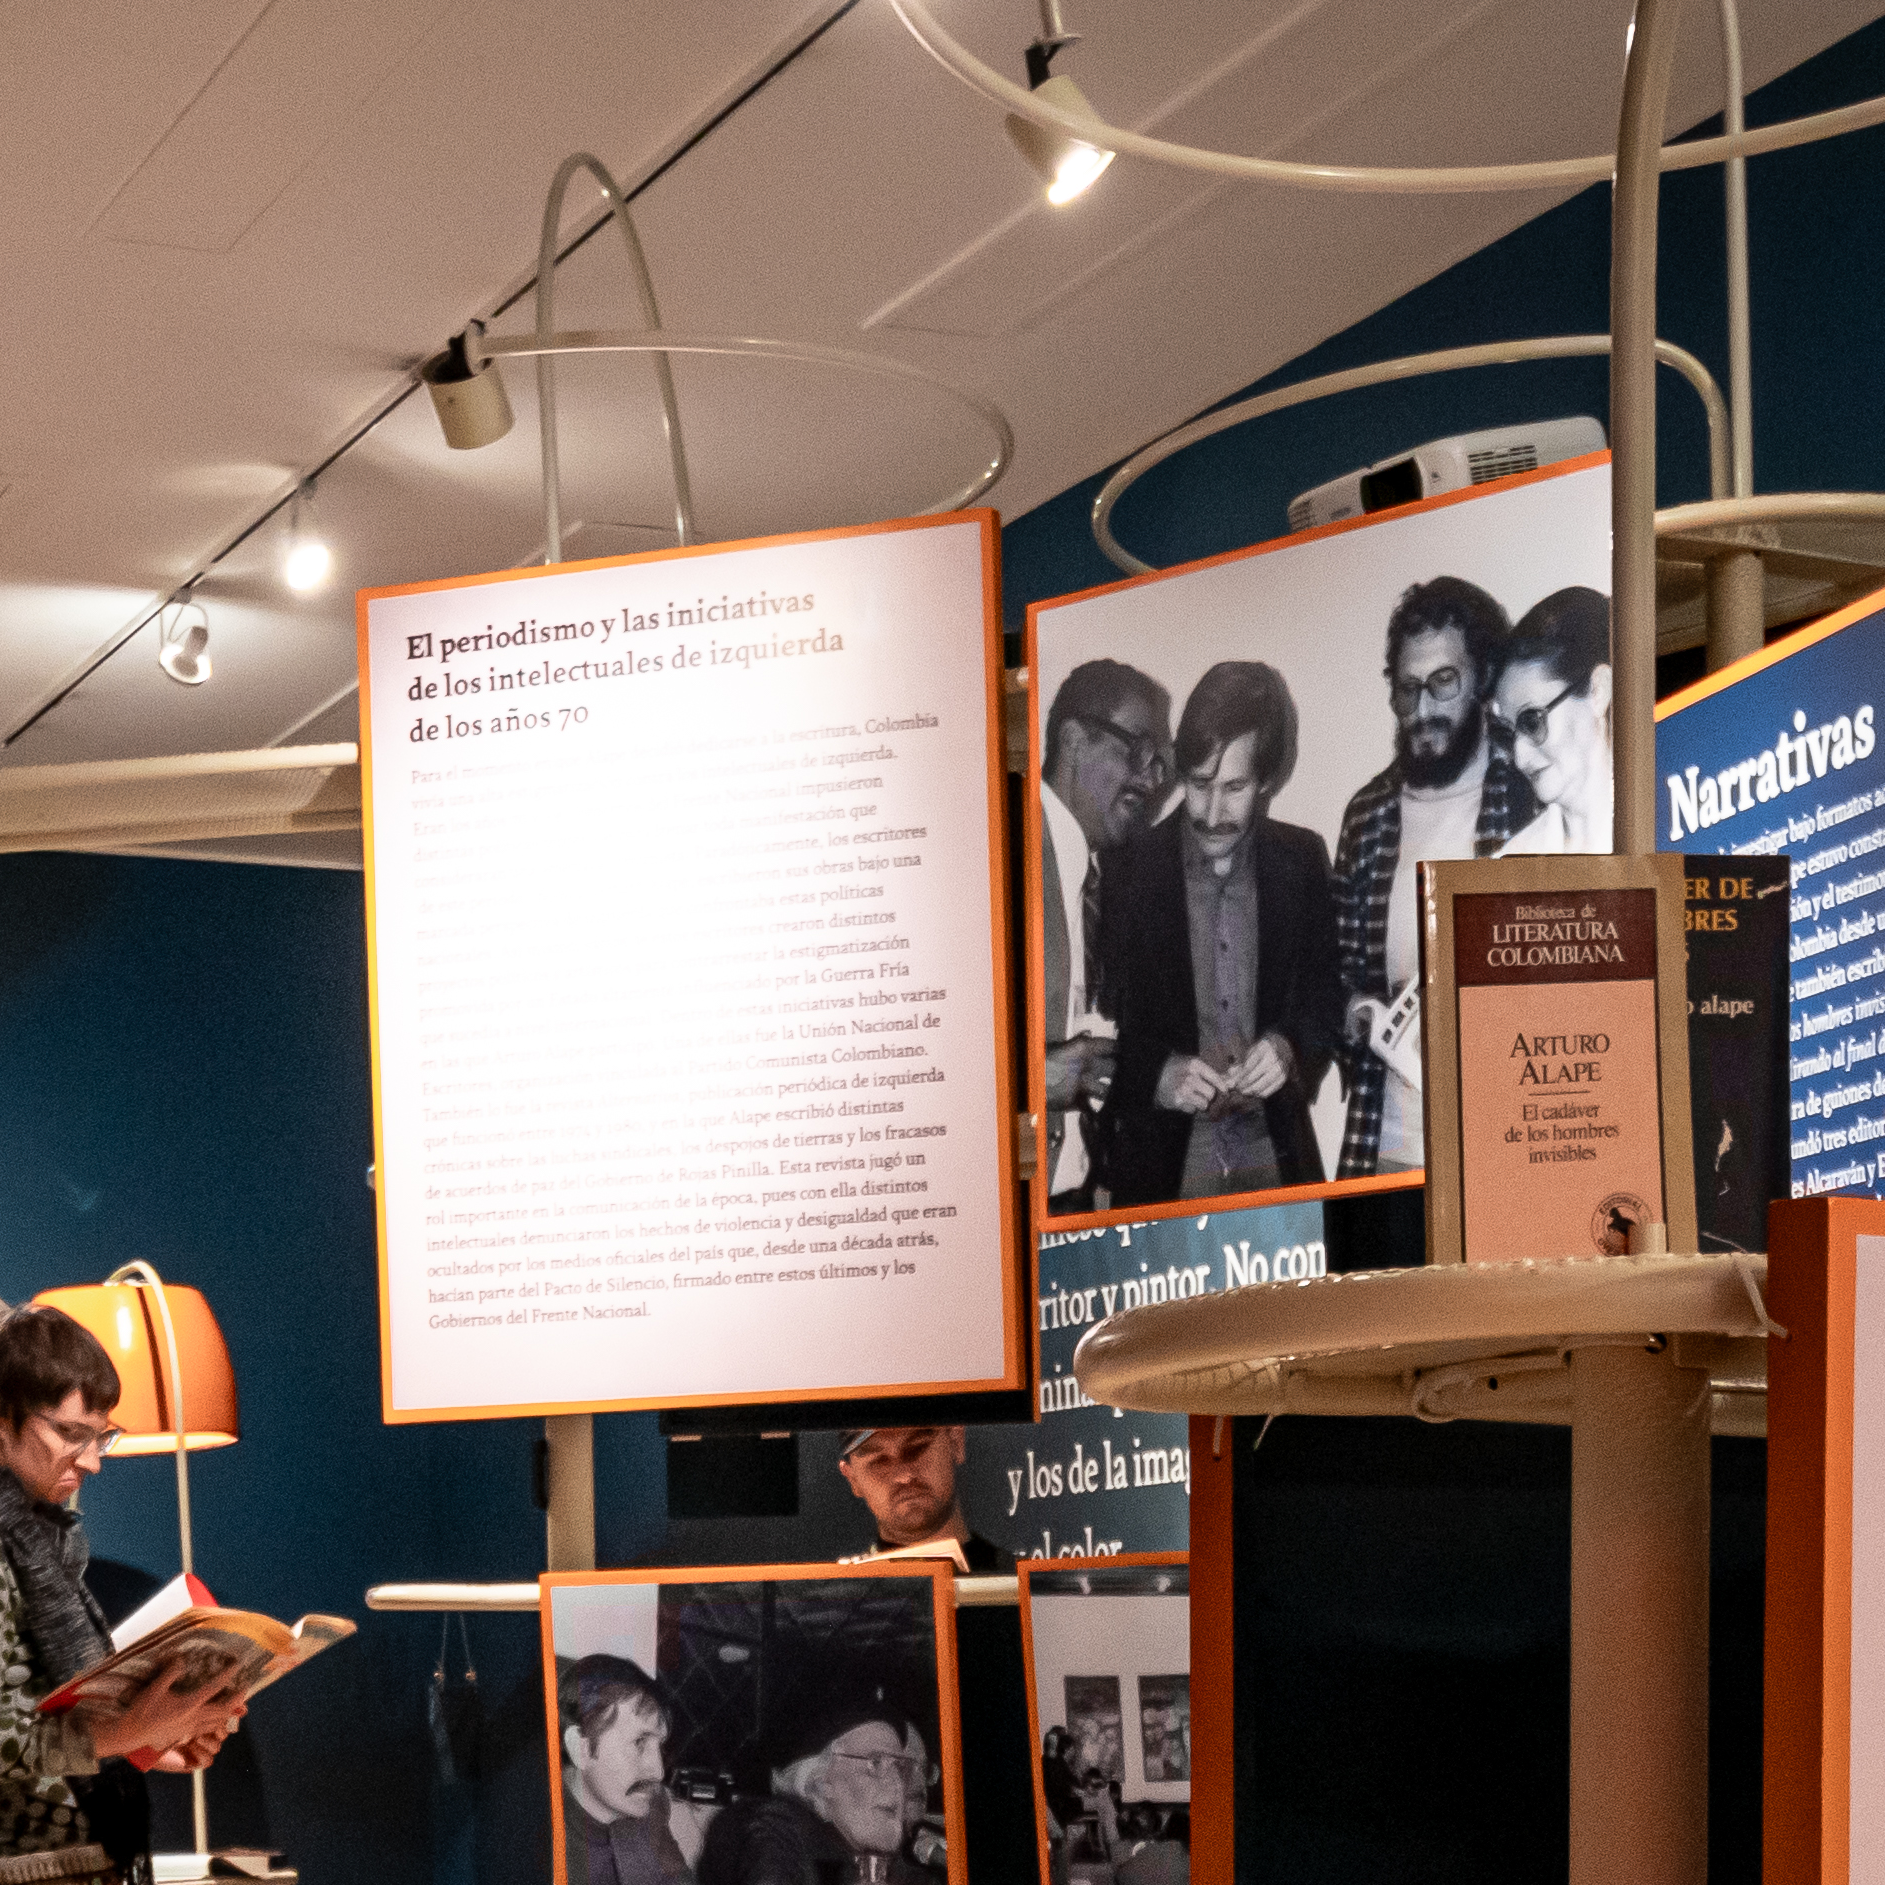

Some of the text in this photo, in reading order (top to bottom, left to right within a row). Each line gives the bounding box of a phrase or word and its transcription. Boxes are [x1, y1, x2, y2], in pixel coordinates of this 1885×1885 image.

[406, 590, 815, 664] El periodismo y las iniciativas
[407, 627, 845, 702] de los intelectuales de izquierda
[409, 705, 589, 743] de los años 70
[1666, 703, 1876, 842] Narrativas
[1515, 904, 1577, 922] Biblioteca
[1492, 920, 1620, 945] LITERATURA
[1486, 943, 1626, 968] COLOMBIANA
[1700, 993, 1756, 1019] alape
[1509, 1031, 1611, 1059] ARTURO
[1518, 1059, 1603, 1086] ALAPE
[1522, 1101, 1601, 1123] El cadáver
[1503, 1121, 1621, 1144] de los hombres
[1528, 1144, 1598, 1165] invisibles
[1221, 1239, 1270, 1291] No
[428, 1258, 916, 1305] hacían parte del Pacto de Silencio, firmado entre estos últimos y los
[428, 1301, 652, 1330] Gobiernos del Frente Nacional.
[1007, 1469, 1024, 1517] y
[1026, 1450, 1064, 1500] los
[1067, 1442, 1100, 1495] de
[1102, 1438, 1129, 1491] la
